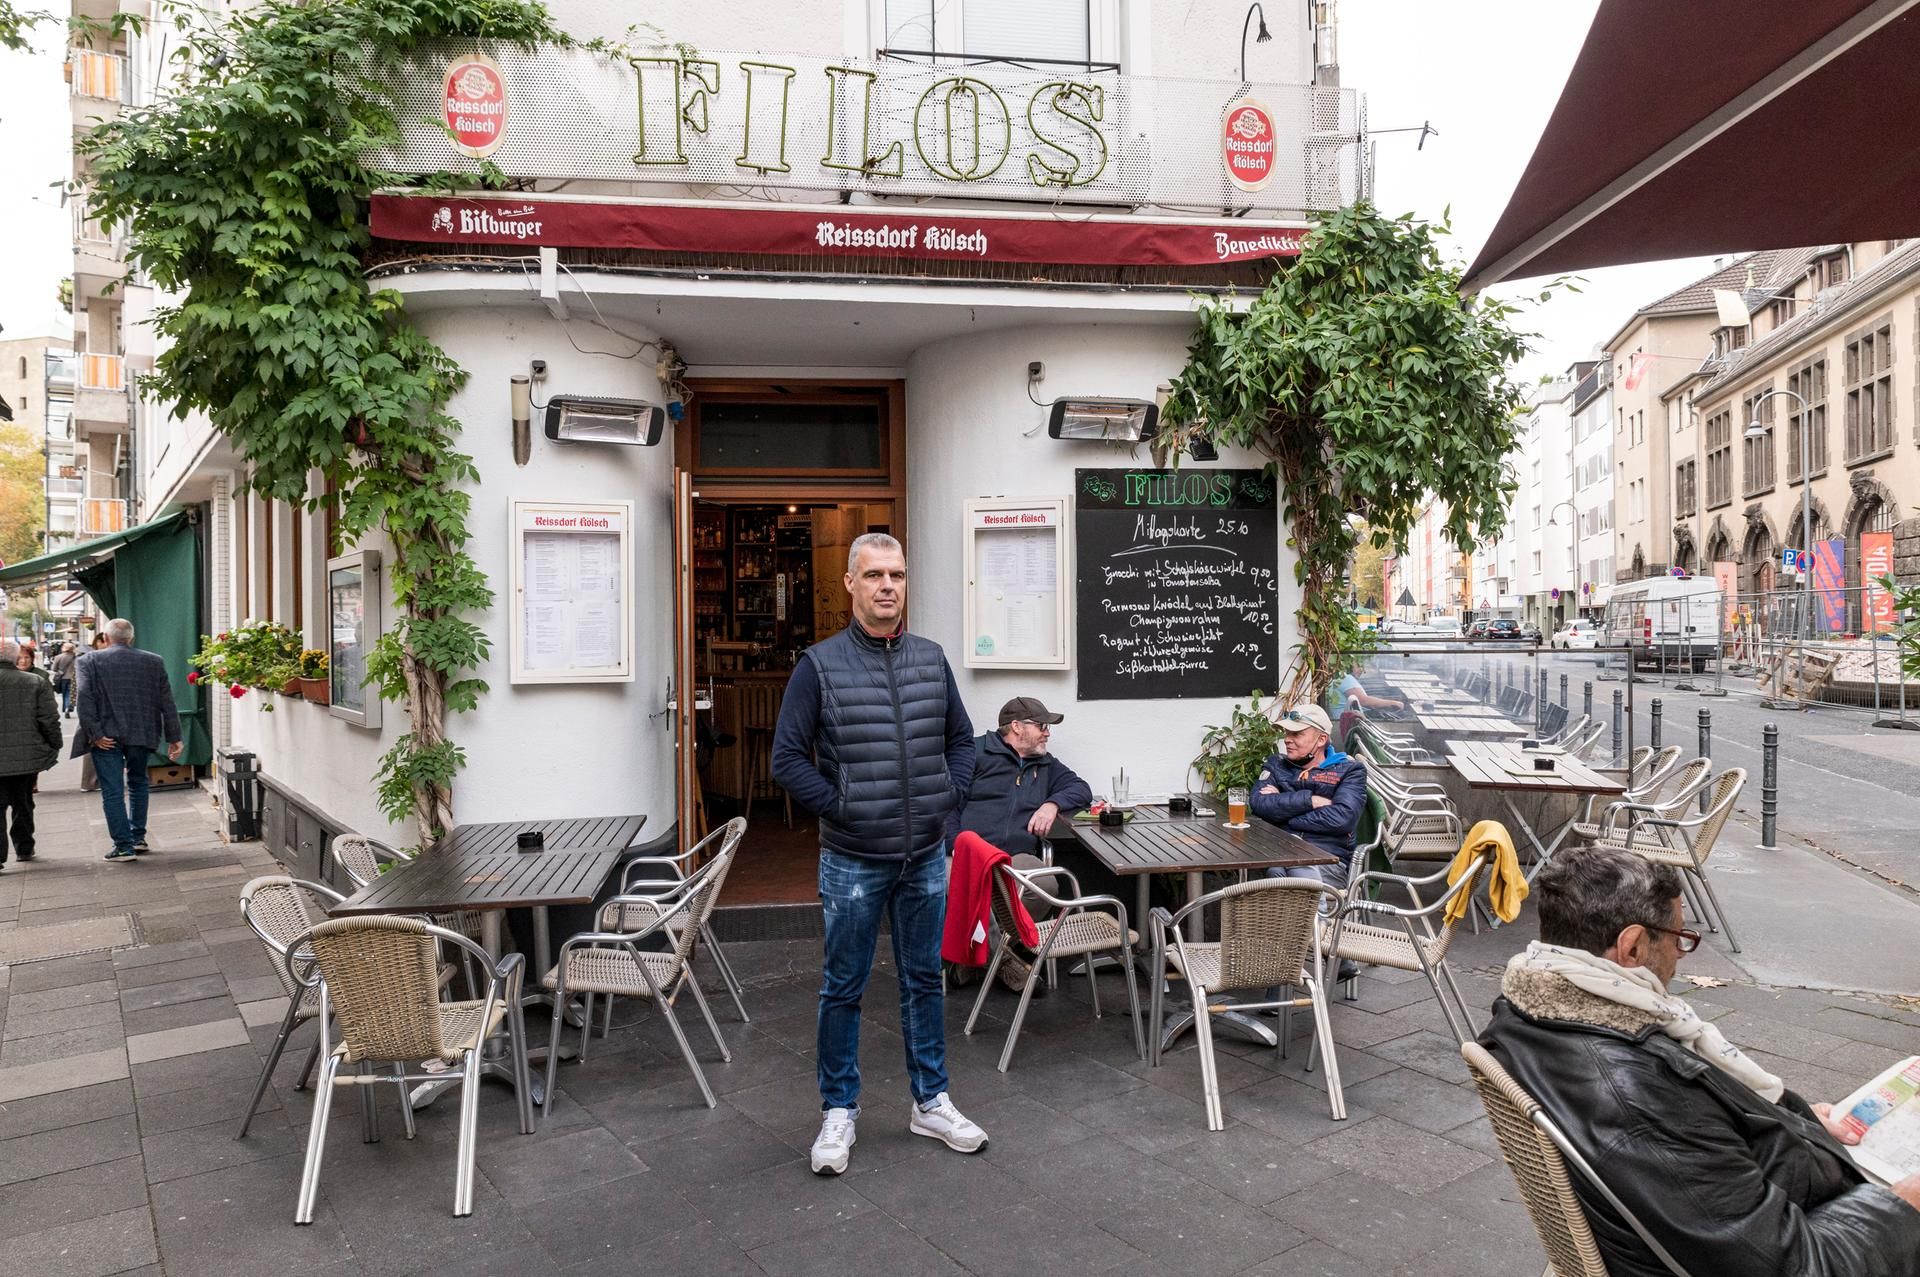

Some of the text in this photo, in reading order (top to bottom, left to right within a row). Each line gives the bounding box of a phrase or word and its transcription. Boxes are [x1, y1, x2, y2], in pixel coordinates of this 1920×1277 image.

[447, 98, 503, 115] Reissdorf
[455, 116, 495, 135] Kölsch
[630, 57, 1107, 187] FILOS
[1226, 137, 1273, 153] Reissdorf
[1233, 154, 1266, 171] Kölsch
[459, 208, 543, 239] Bitburger
[815, 221, 988, 256] Reissdorf Kölsch
[1124, 474, 1232, 506] FILOS
[535, 516, 609, 529] Reissdorf Kölsch
[984, 513, 1046, 524] Reissdorf Kölsch
[1132, 513, 1206, 547] Mittagskarte
[1101, 563, 1140, 586] Gnocchi
[1144, 559, 1162, 577] mit
[1866, 545, 1889, 616] COMDIA
[1147, 579, 1156, 589] in
[1133, 646, 1148, 657] mit
